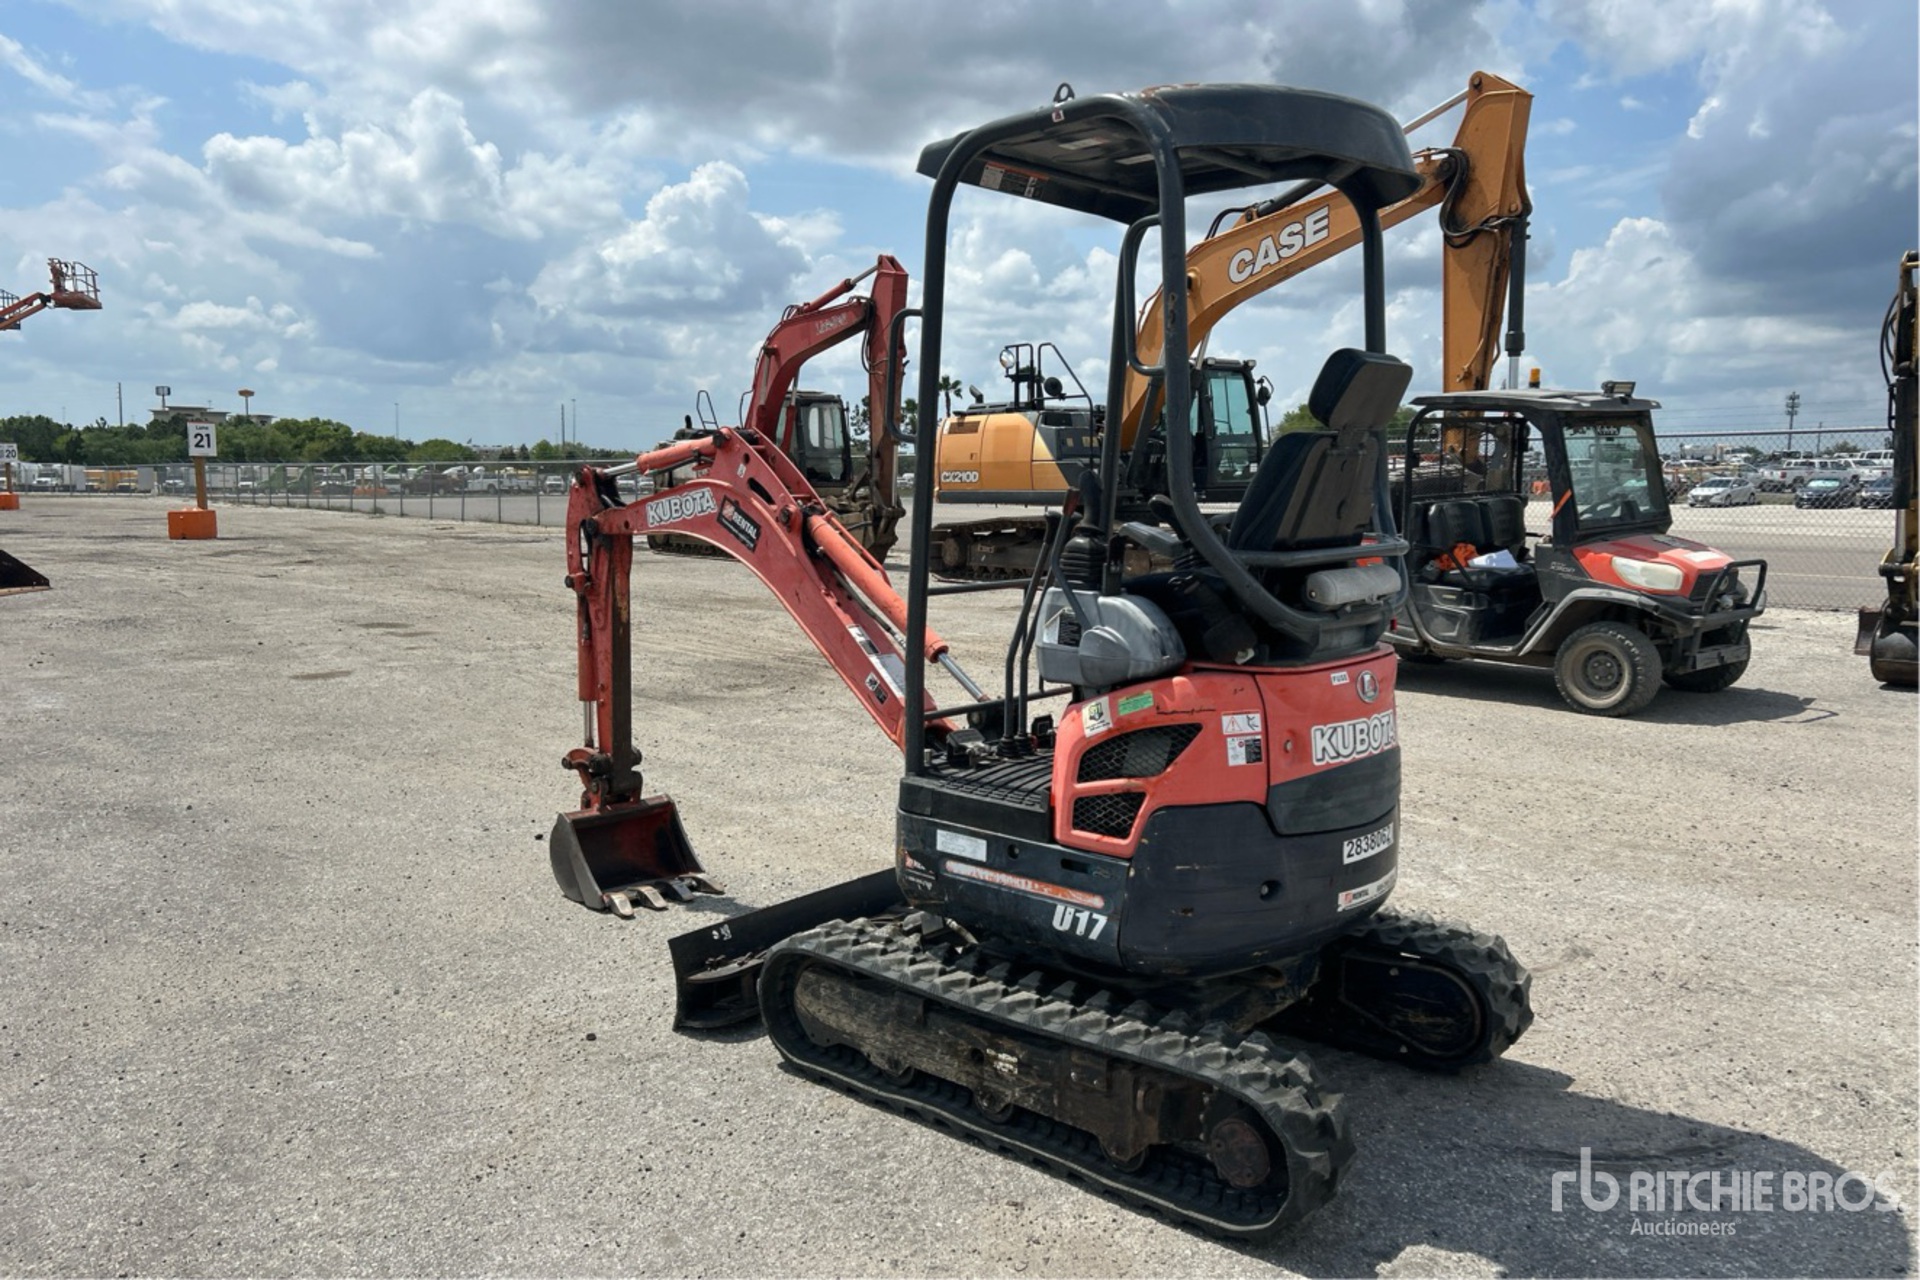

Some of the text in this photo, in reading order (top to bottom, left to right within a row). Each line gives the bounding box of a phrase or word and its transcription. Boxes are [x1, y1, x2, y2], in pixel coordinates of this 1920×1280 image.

[1229, 204, 1330, 284] CASE
[5, 449, 16, 459] 20
[193, 433, 211, 448] 21
[646, 488, 717, 528] KUBOTA
[732, 511, 758, 540] RENTAL
[1052, 904, 1108, 941] U17
